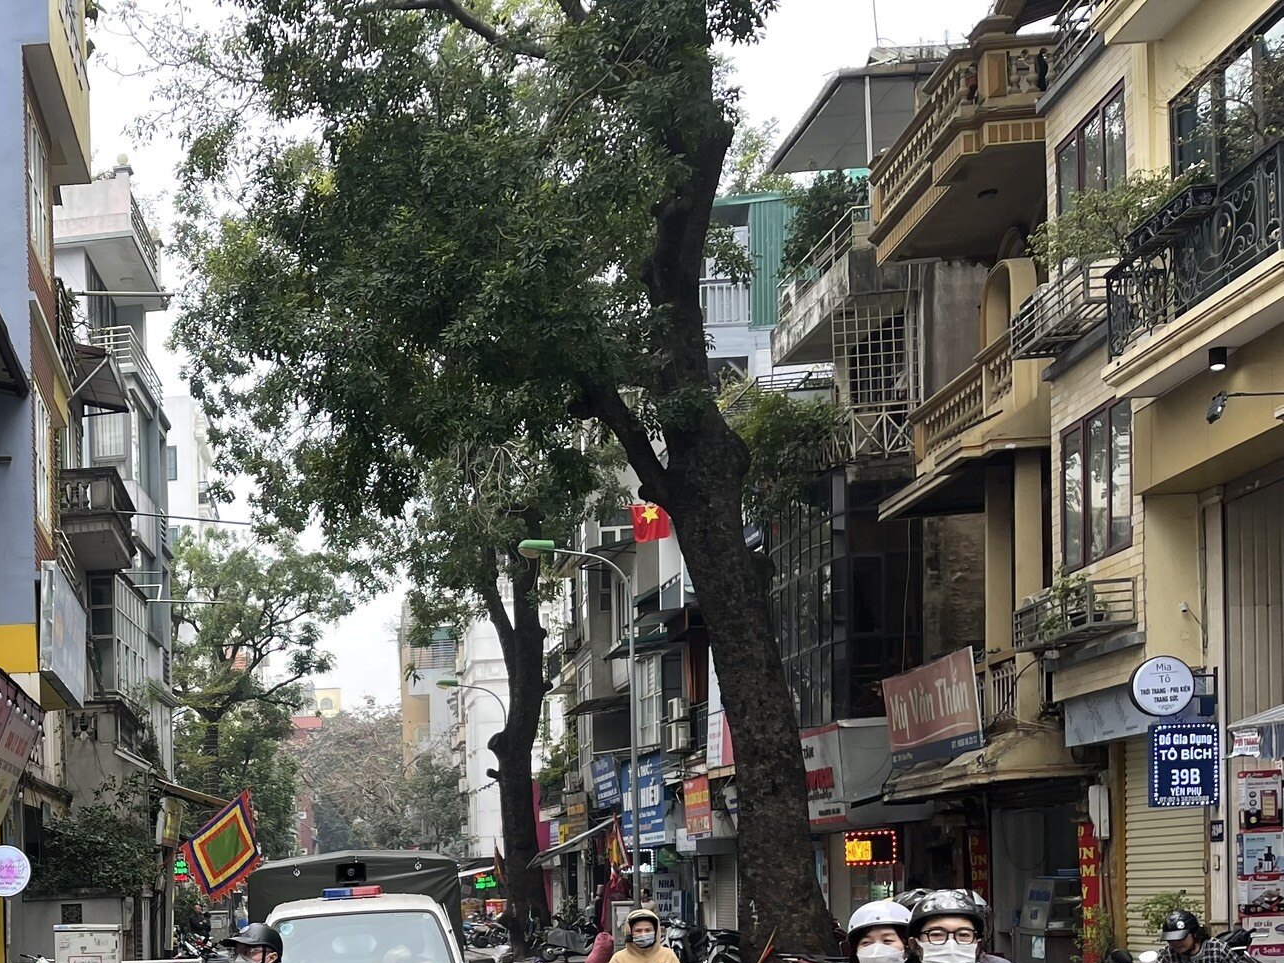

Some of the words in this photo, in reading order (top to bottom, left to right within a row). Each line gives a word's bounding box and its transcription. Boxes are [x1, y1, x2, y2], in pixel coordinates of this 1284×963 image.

[1156, 663, 1172, 671] Mia
[1159, 674, 1171, 683] Tô
[1159, 746, 1178, 761] TÔ
[1180, 746, 1213, 760] BÍCH
[1170, 768, 1201, 786] 39B
[1170, 786, 1186, 797] YÊN
[1186, 786, 1202, 798] PHỤ
